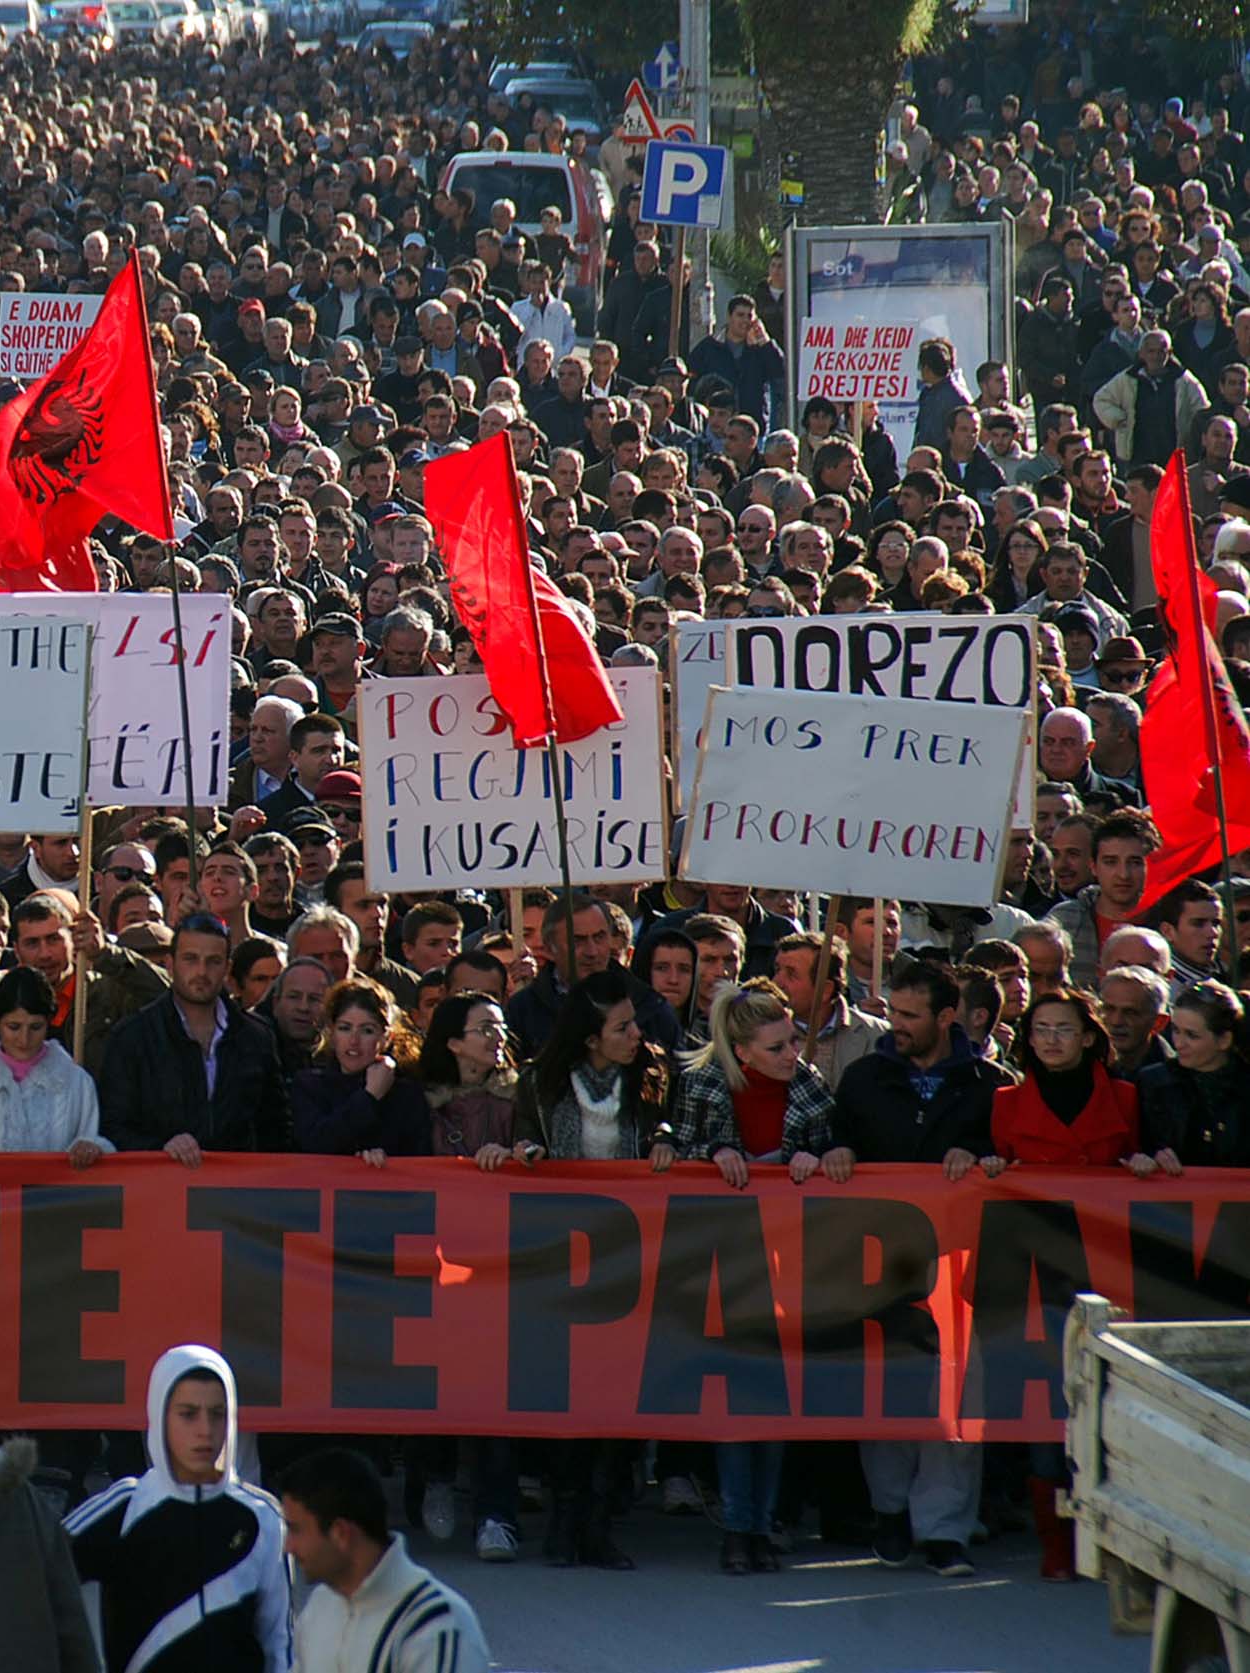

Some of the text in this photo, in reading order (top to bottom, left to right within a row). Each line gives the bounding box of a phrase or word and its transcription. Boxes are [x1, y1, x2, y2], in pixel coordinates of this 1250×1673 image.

[656, 150, 708, 215] P
[822, 260, 854, 277] Sot
[9, 300, 83, 322] E DUAM
[804, 326, 914, 349] ANA DHE KEIDI
[0, 351, 11, 373] SI
[813, 351, 903, 371] KERKOJNE
[807, 374, 910, 398] DREJTESI
[724, 716, 982, 768] MOS PREK
[376, 741, 623, 807] REGJIMI
[702, 801, 1000, 863] PROKUROREN
[186, 1187, 439, 1409] TE
